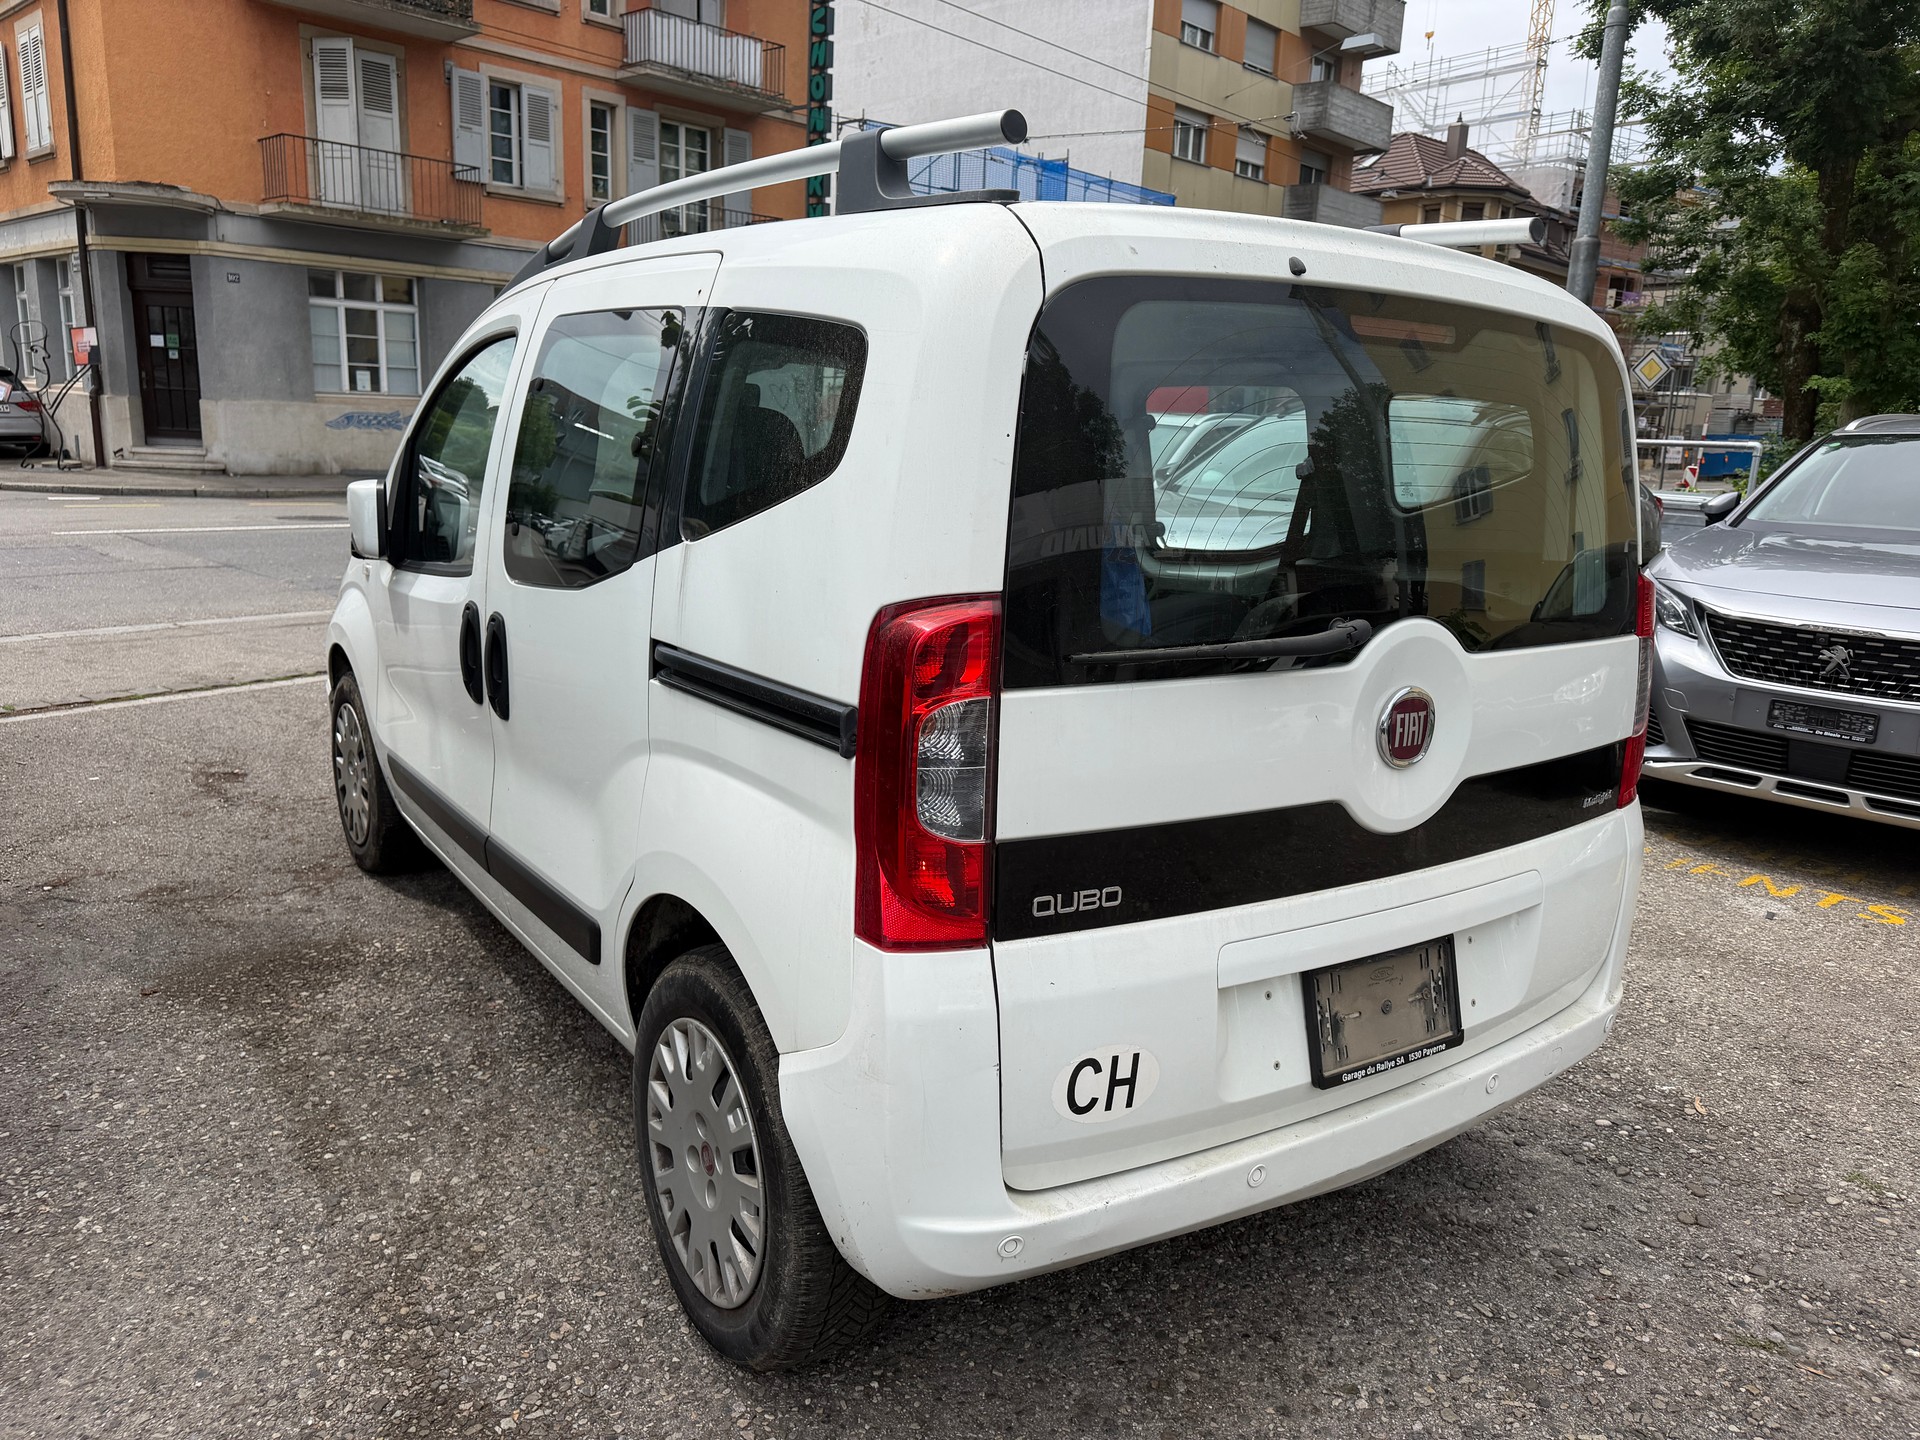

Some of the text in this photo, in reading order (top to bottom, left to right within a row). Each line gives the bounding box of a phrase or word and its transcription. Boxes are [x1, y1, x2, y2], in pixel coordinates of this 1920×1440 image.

[1394, 711, 1427, 748] FIAT
[1032, 885, 1122, 917] QUBO
[1342, 1043, 1446, 1082] Garage du Rallye SA 1530 Payerne
[1066, 1052, 1140, 1115] CH
